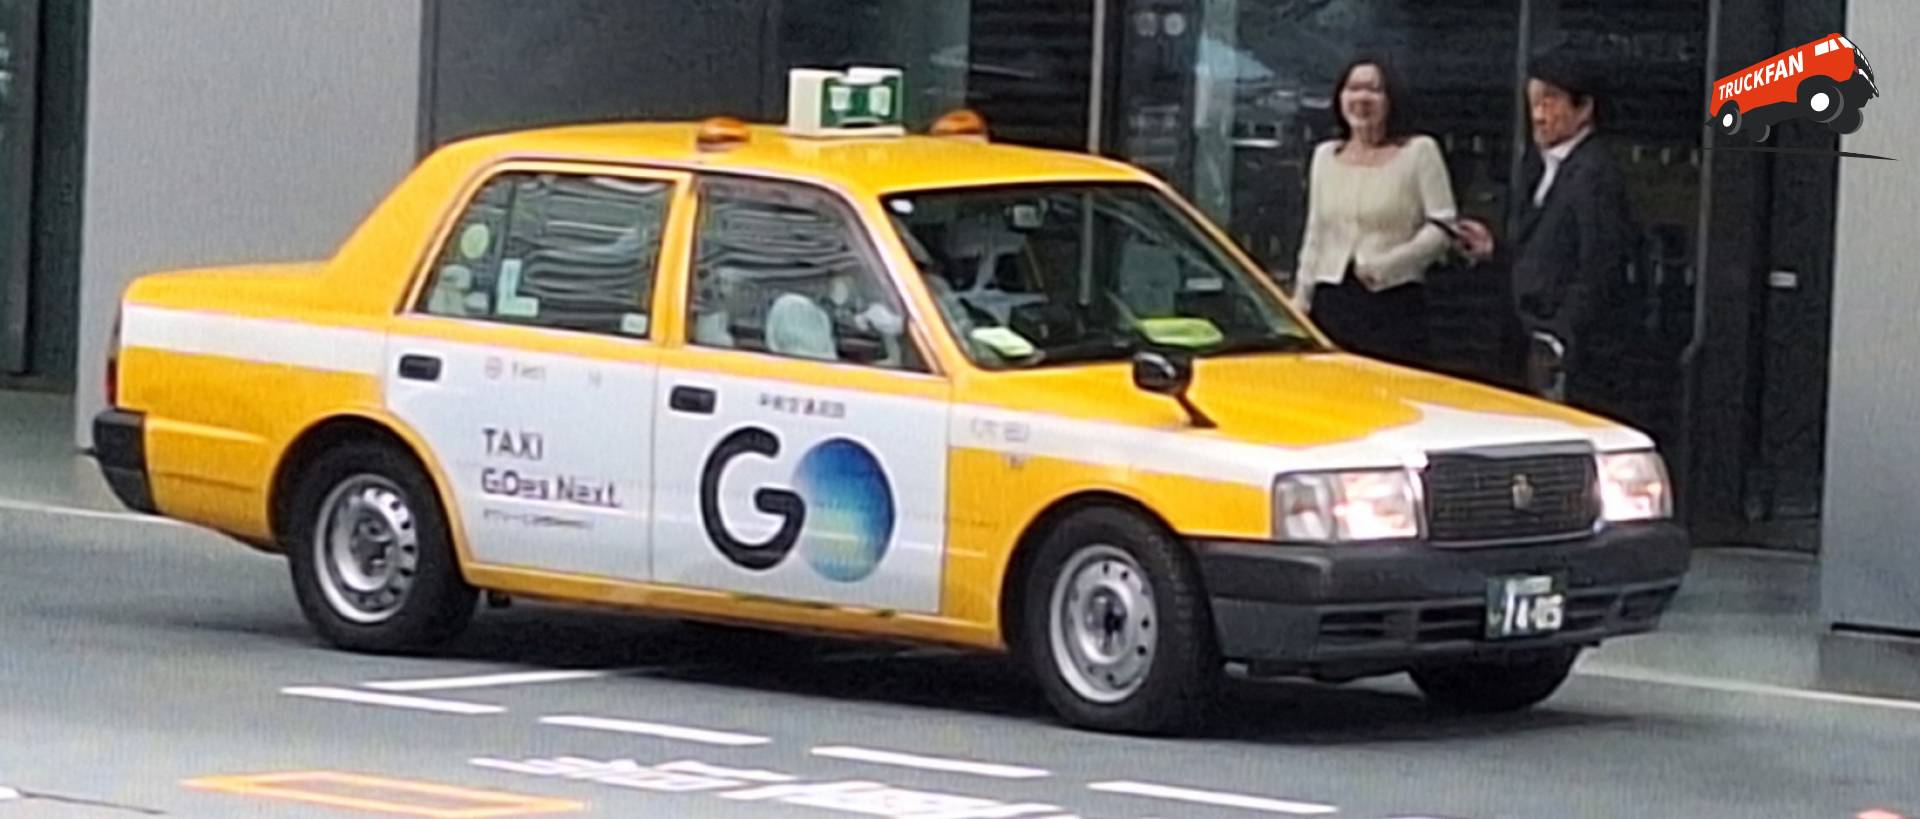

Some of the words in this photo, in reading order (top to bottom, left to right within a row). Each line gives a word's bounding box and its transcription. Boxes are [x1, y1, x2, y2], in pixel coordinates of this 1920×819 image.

[483, 428, 544, 460] TAXI
[556, 474, 622, 507] Next
[700, 425, 897, 583] GO
